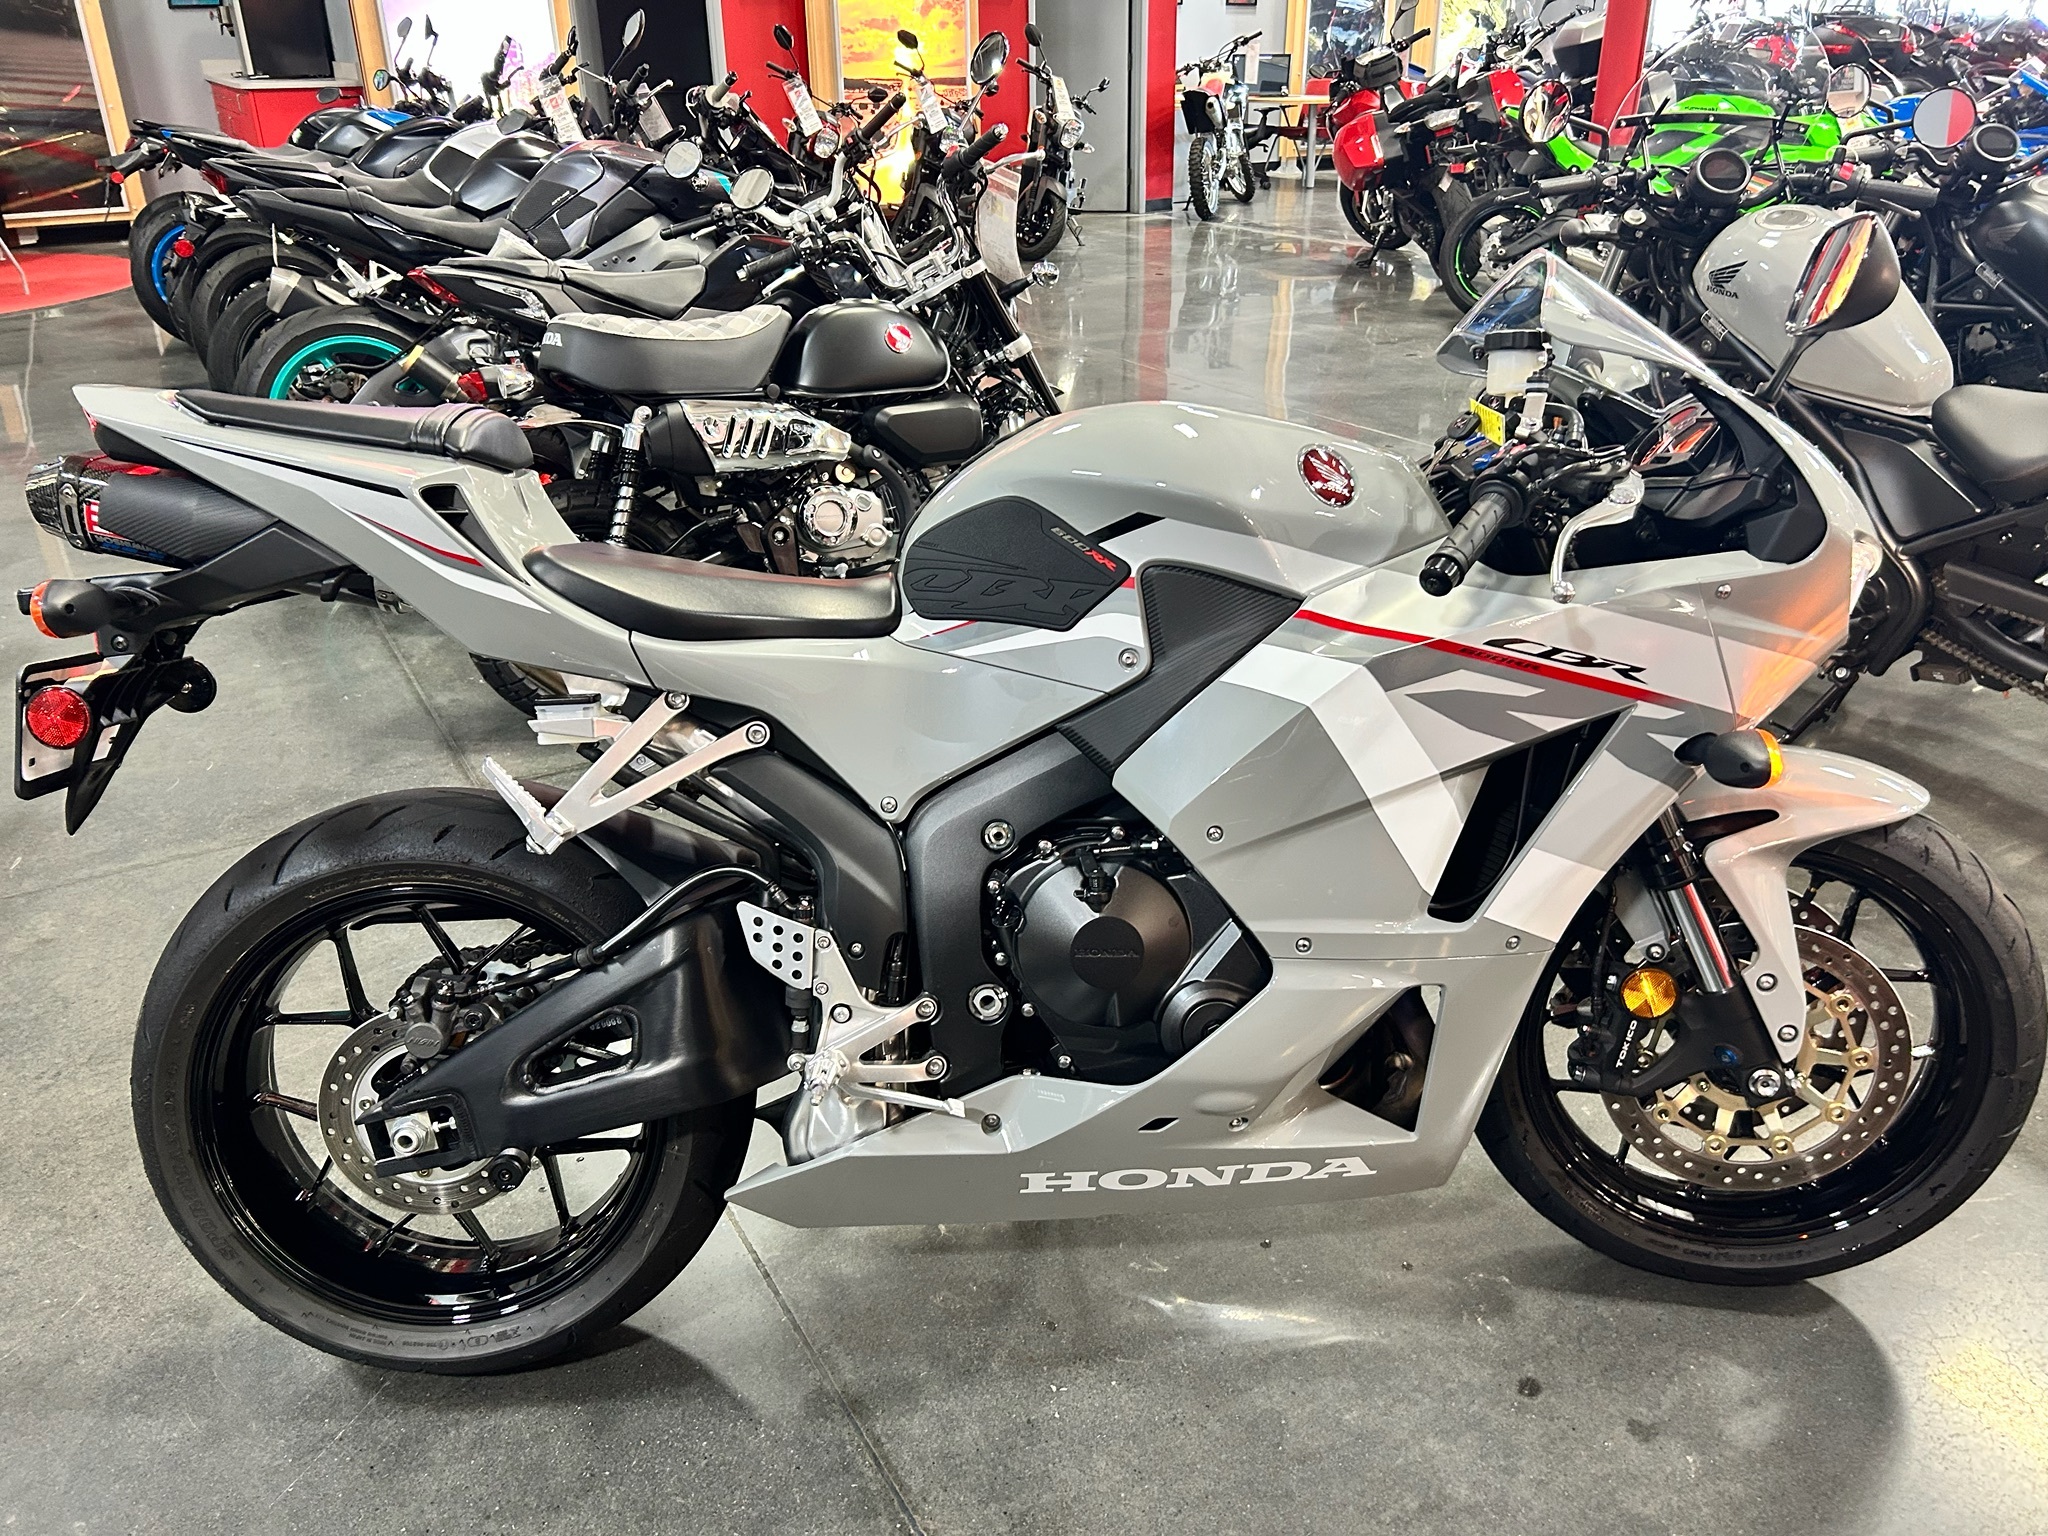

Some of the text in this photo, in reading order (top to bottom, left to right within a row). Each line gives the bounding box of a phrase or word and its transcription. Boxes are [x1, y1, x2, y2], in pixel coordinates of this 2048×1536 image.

[1706, 285, 1740, 299] HONDA
[1482, 638, 1648, 685] CBR
[1615, 1020, 1638, 1068] TOKICO
[1019, 1156, 1378, 1193] HONDA
